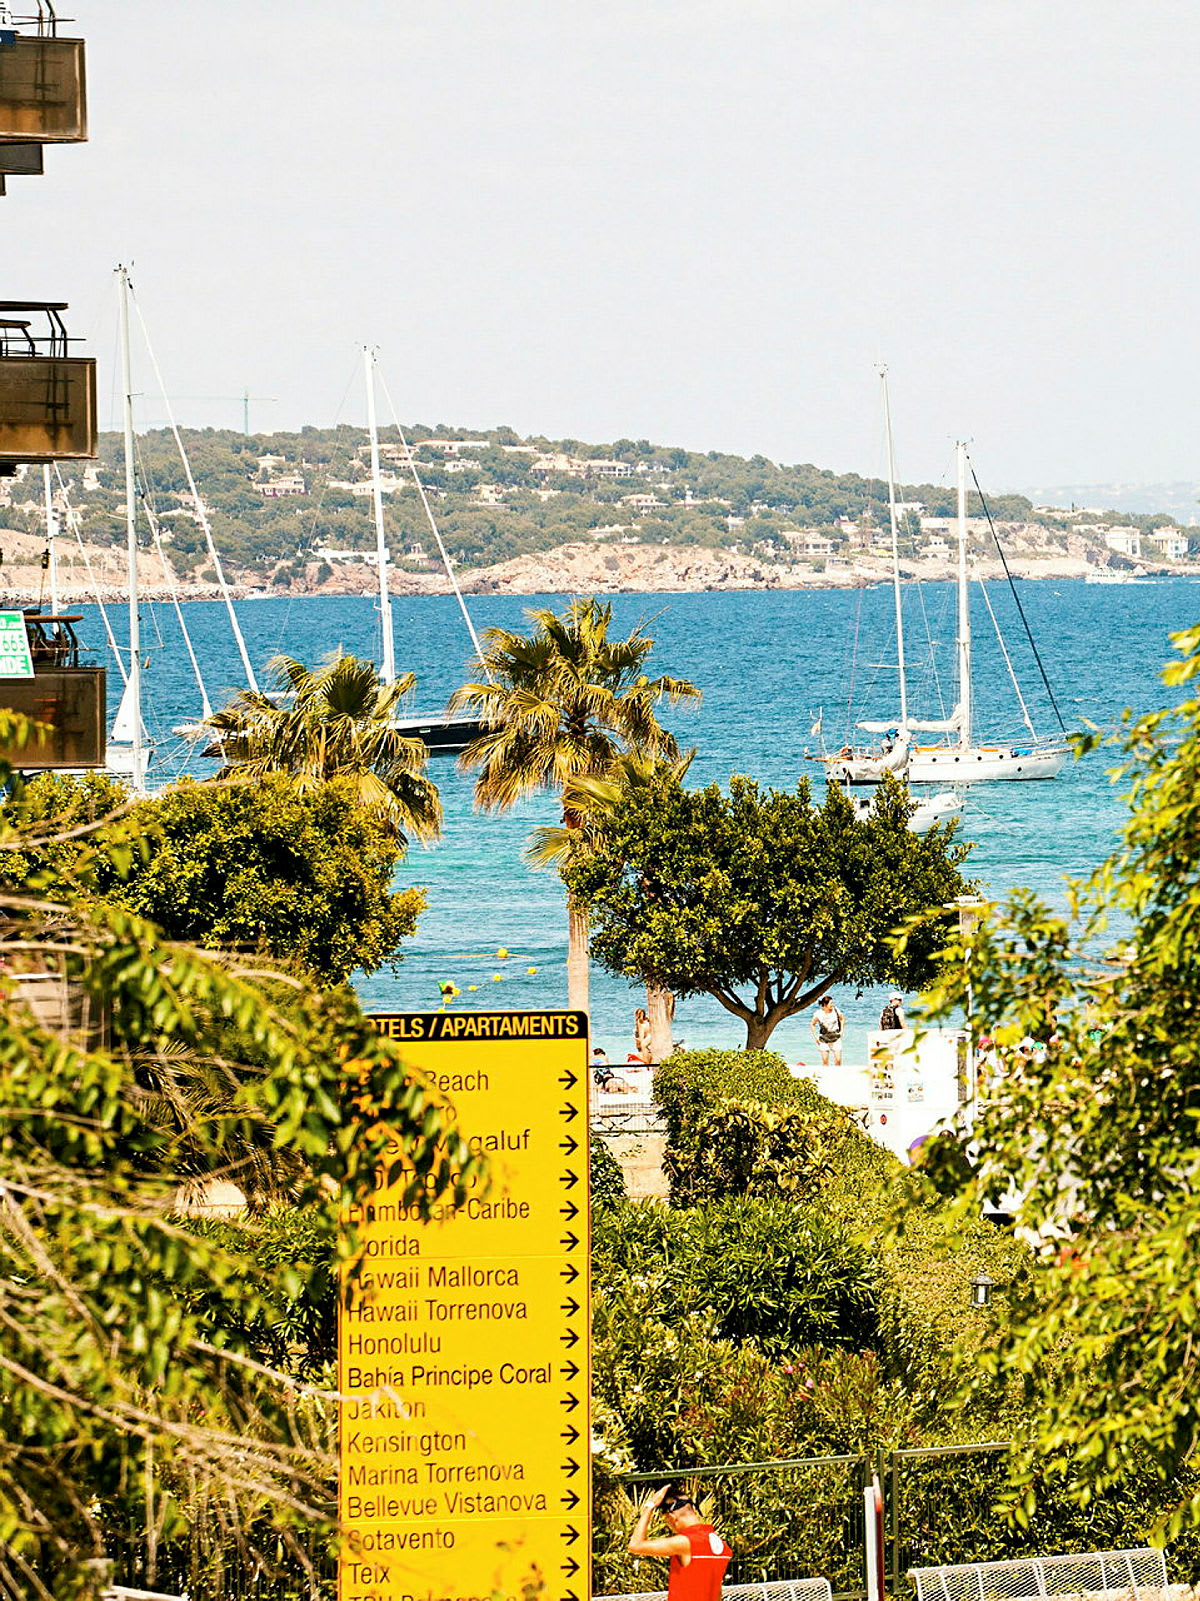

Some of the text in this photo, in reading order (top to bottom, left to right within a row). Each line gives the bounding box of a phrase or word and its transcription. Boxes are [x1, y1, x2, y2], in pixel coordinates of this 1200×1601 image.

[366, 1018, 424, 1038] TELS
[440, 1015, 579, 1037] APARTAMENTS
[428, 1266, 520, 1288] Mallorca
[348, 1299, 528, 1323] Hawaii Torrenova
[348, 1332, 441, 1355] Honolulu
[348, 1363, 551, 1389] Bahía Principe Coral
[347, 1430, 466, 1456] Kensington
[348, 1462, 525, 1486] Marina Torrenova
[348, 1492, 547, 1518] Bellevue Vistanova
[347, 1529, 455, 1551] Sotavento
[348, 1562, 390, 1584] Teix
